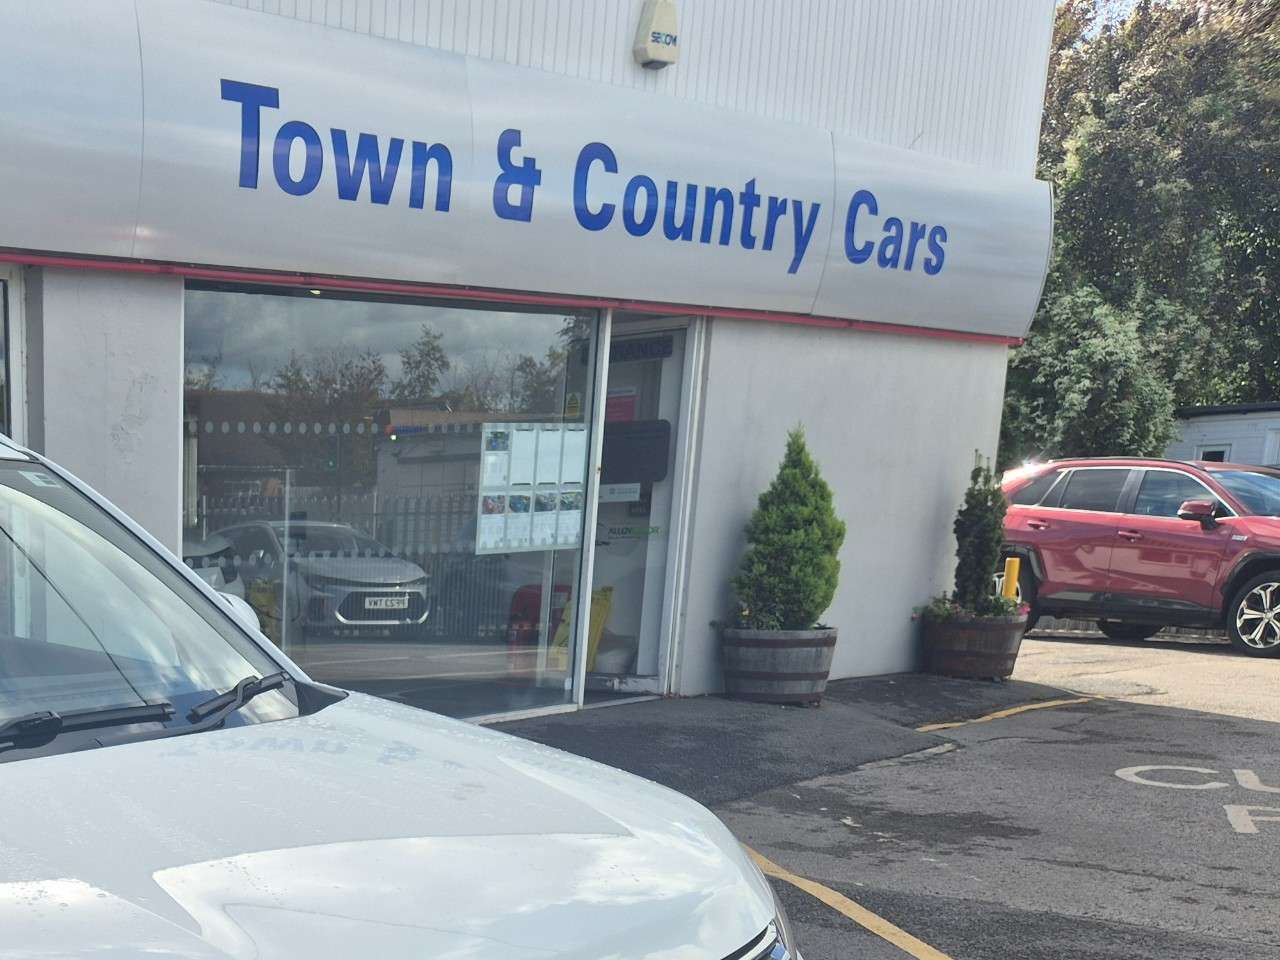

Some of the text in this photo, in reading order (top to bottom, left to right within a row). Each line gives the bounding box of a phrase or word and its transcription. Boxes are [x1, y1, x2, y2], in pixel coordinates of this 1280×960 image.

[220, 79, 948, 276] Town & Country Cars
